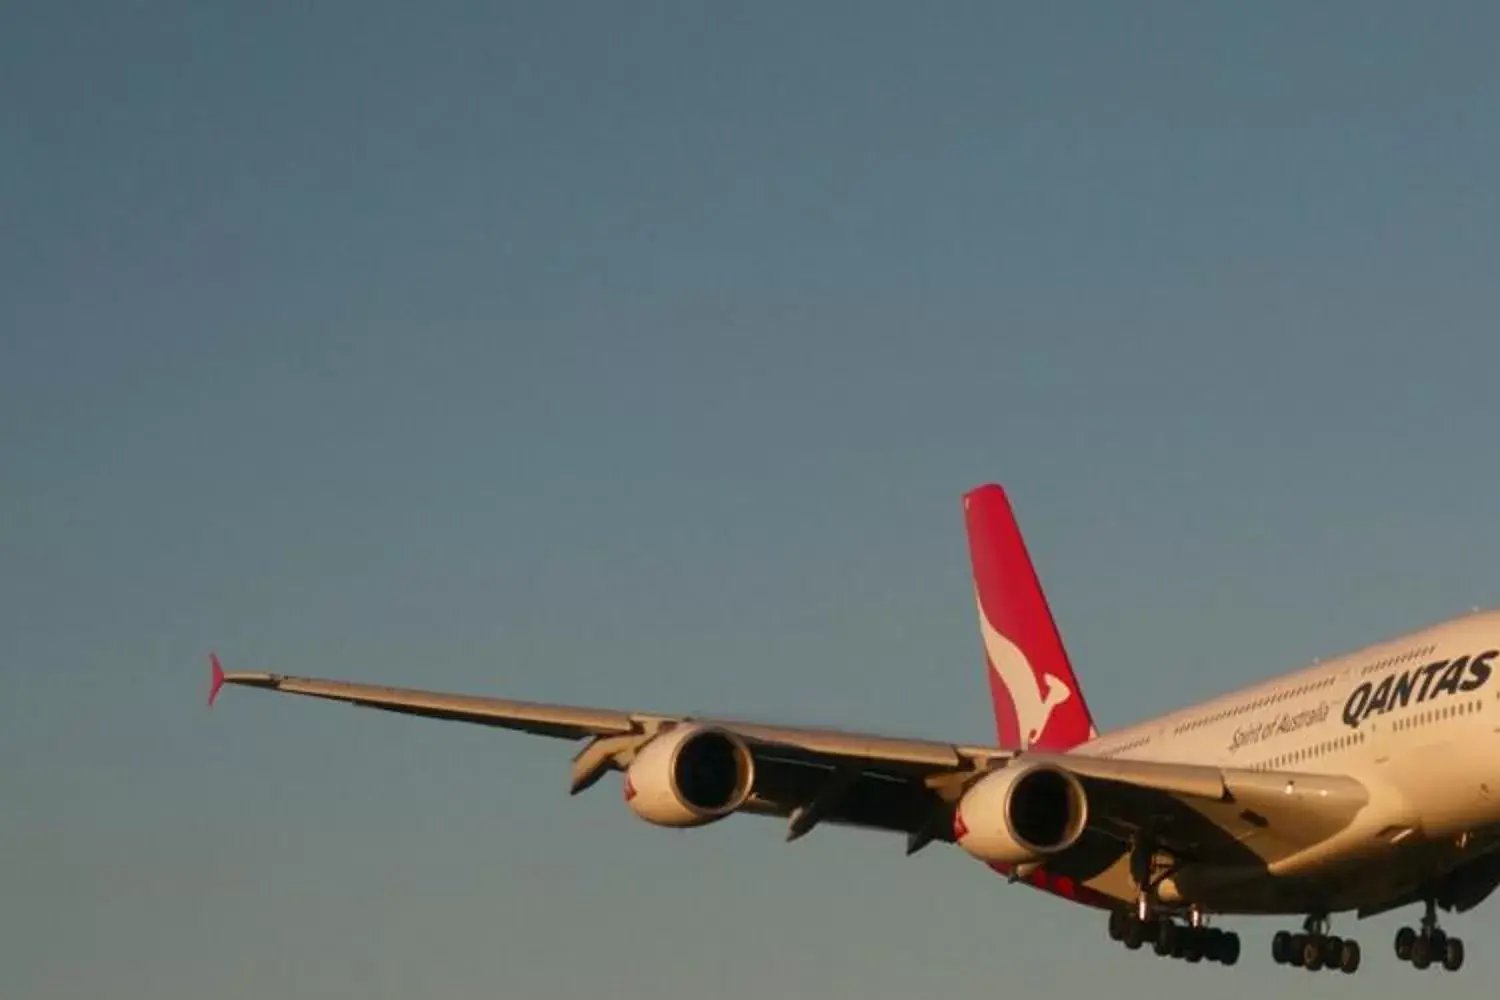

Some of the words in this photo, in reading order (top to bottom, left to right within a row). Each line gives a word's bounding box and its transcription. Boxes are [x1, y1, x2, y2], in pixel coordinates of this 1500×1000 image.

[1342, 650, 1500, 728] QANTAS
[1228, 723, 1262, 753] Spirit
[1261, 712, 1281, 740] of
[1275, 701, 1330, 735] Australia
